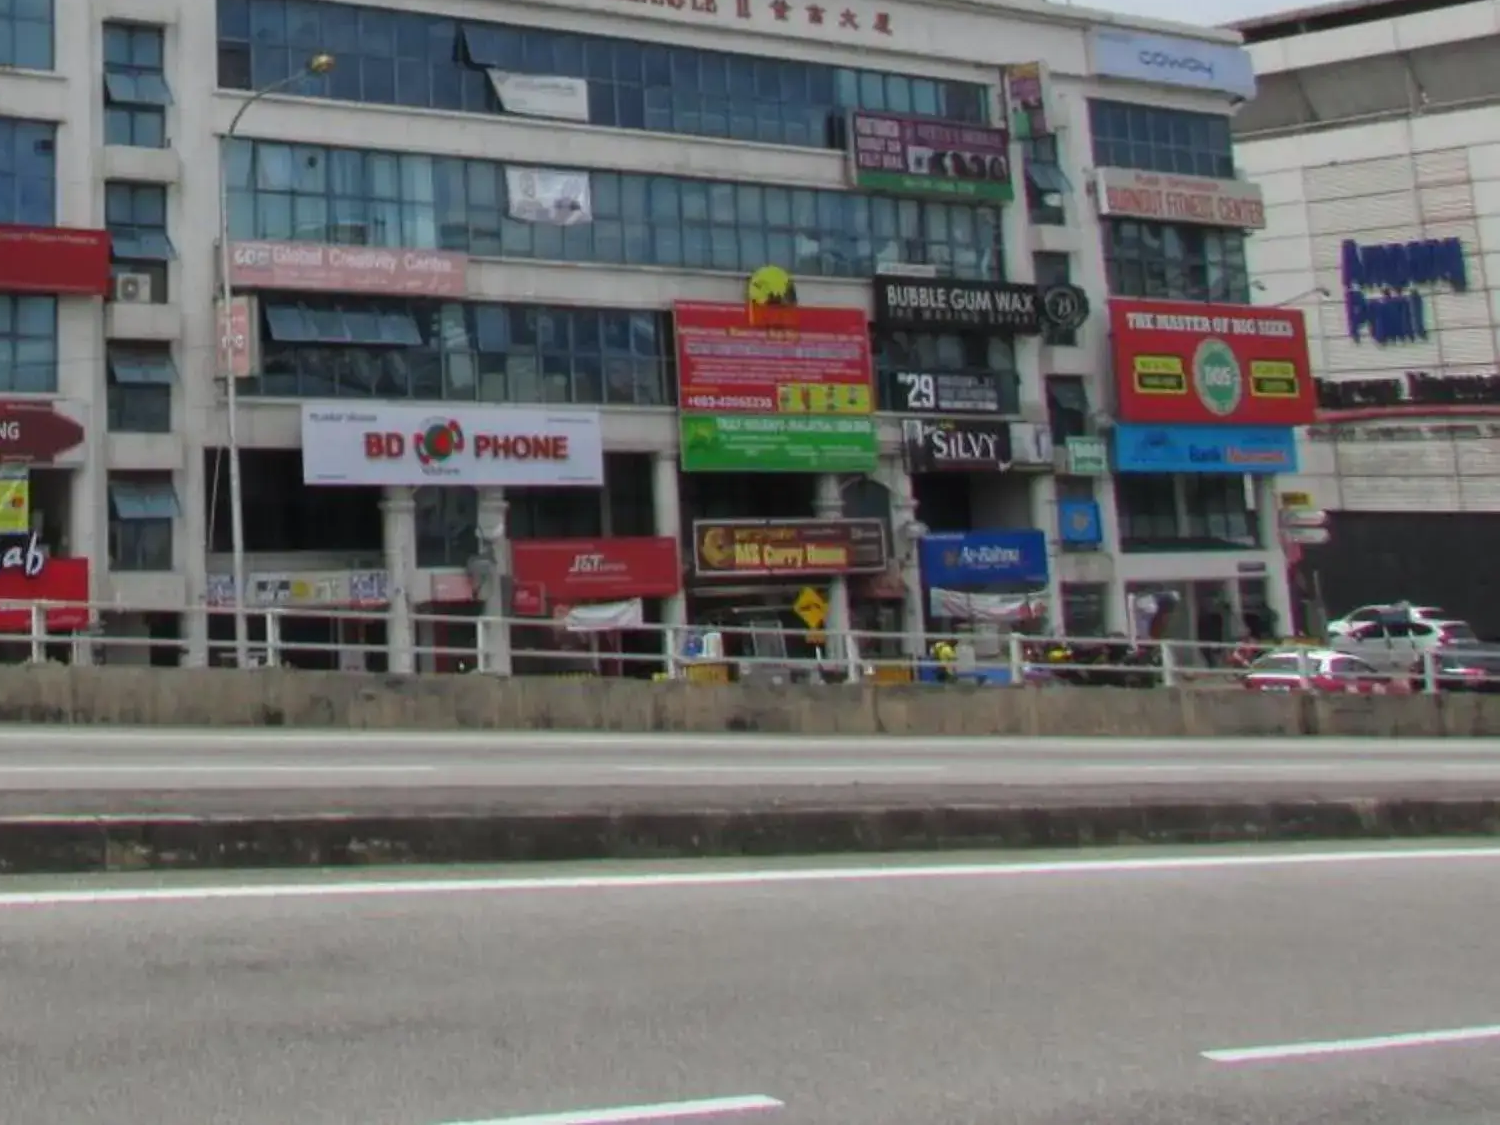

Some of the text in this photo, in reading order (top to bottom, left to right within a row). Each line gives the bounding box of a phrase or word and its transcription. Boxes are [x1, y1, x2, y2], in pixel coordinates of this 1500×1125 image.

[273, 245, 322, 267] Global
[329, 249, 397, 275] Creativity
[887, 284, 1035, 314] BUBBLE GUM WAX
[1126, 312, 1154, 330] THE
[1156, 314, 1210, 333] MASTER
[908, 374, 935, 408] 29
[364, 431, 569, 460] BD PHONE
[569, 553, 603, 573] J&T
